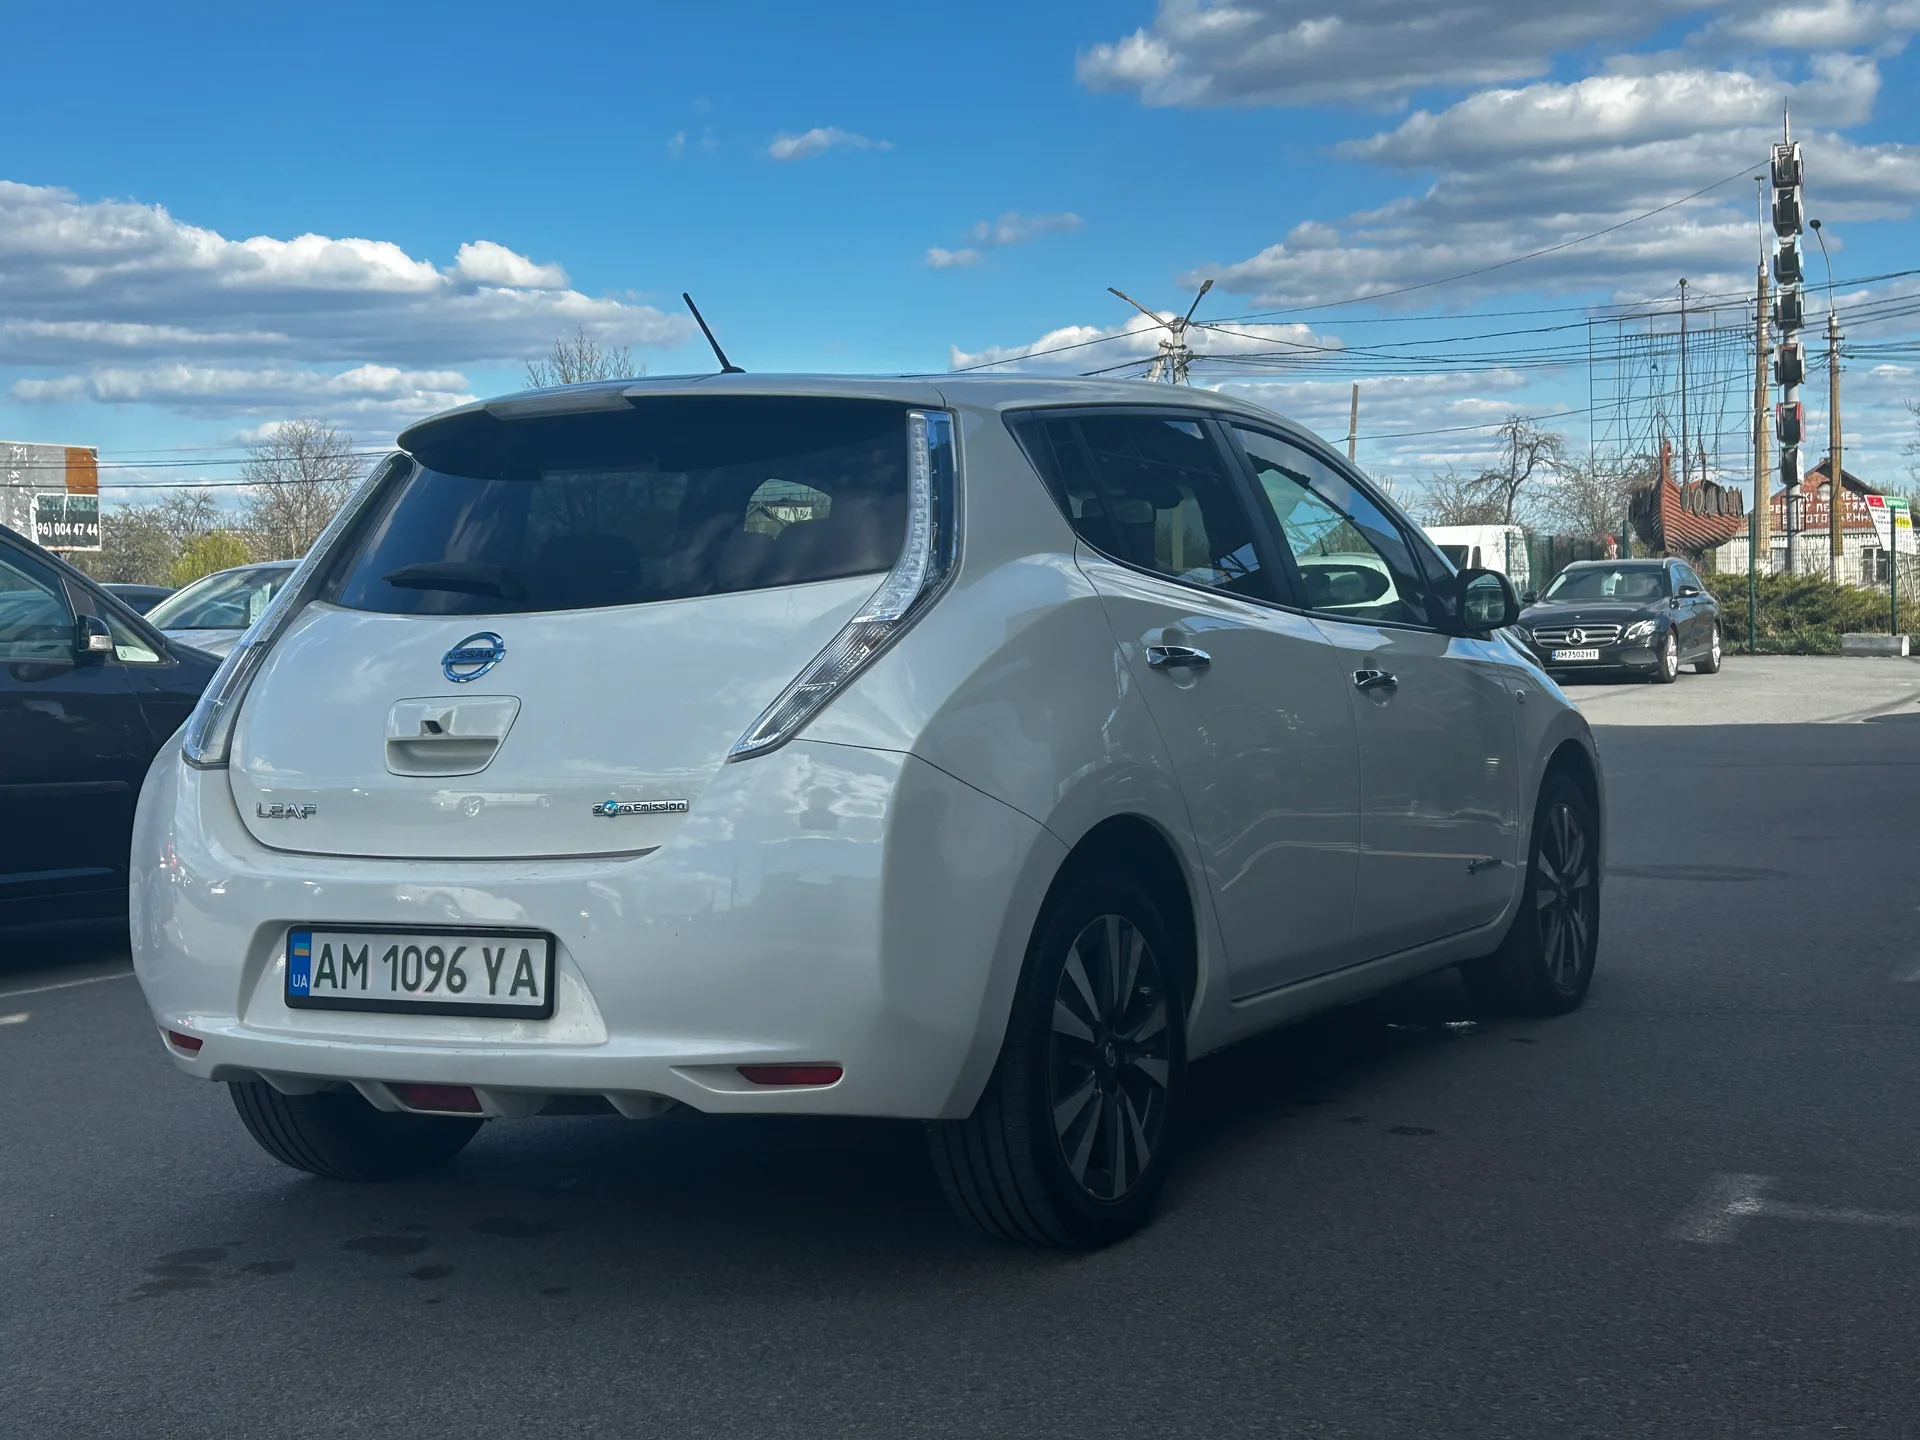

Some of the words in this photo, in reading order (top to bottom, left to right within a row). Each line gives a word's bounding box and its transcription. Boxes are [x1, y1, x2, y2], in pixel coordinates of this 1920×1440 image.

[54, 523, 71, 536] 004
[73, 523, 84, 536] 47
[86, 523, 98, 536] 44
[447, 649, 496, 659] NISSAN
[256, 802, 316, 819] LEAF
[313, 943, 368, 990] AM
[382, 945, 467, 994] 1096
[482, 947, 538, 997] YA
[292, 974, 308, 988] UA
